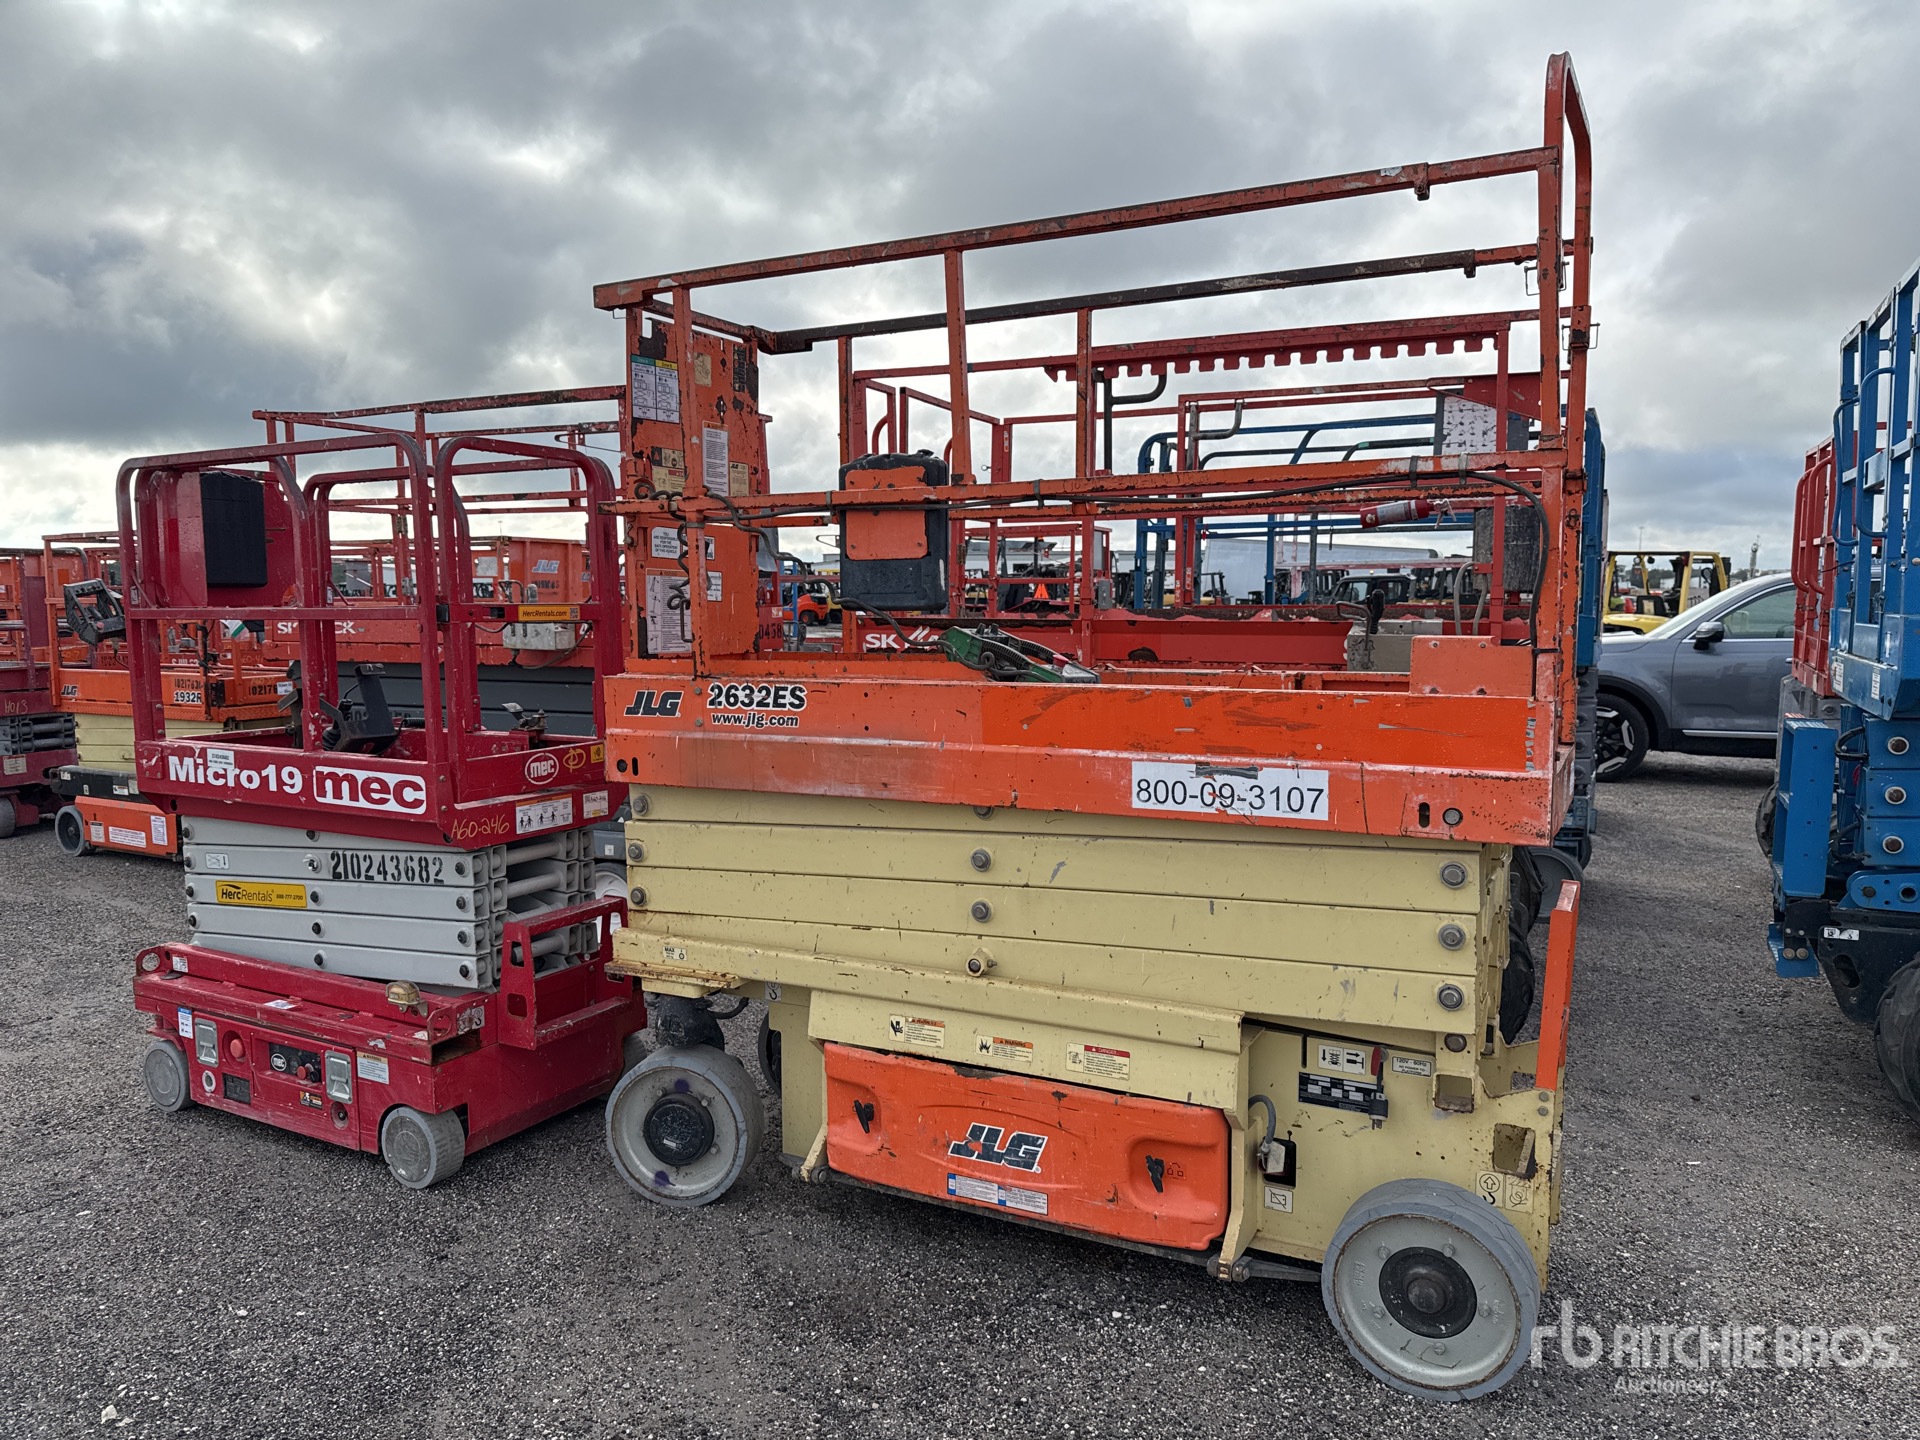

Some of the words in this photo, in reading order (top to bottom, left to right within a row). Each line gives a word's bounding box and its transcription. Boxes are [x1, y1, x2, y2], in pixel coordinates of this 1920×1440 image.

[532, 559, 560, 573] JLG
[60, 685, 78, 696] JLG
[624, 690, 684, 718] JLG
[707, 683, 808, 711] 2632ES
[711, 712, 801, 728] www.jlg.com
[168, 755, 304, 795] Micro19
[530, 759, 555, 778] mec
[315, 770, 425, 810] mec
[1135, 778, 1325, 813] 800-09-3107
[329, 850, 445, 884] 210243682
[221, 888, 273, 902] HercRentals
[1005, 1040, 1026, 1048] WARNING
[948, 1123, 1048, 1172] JLG
